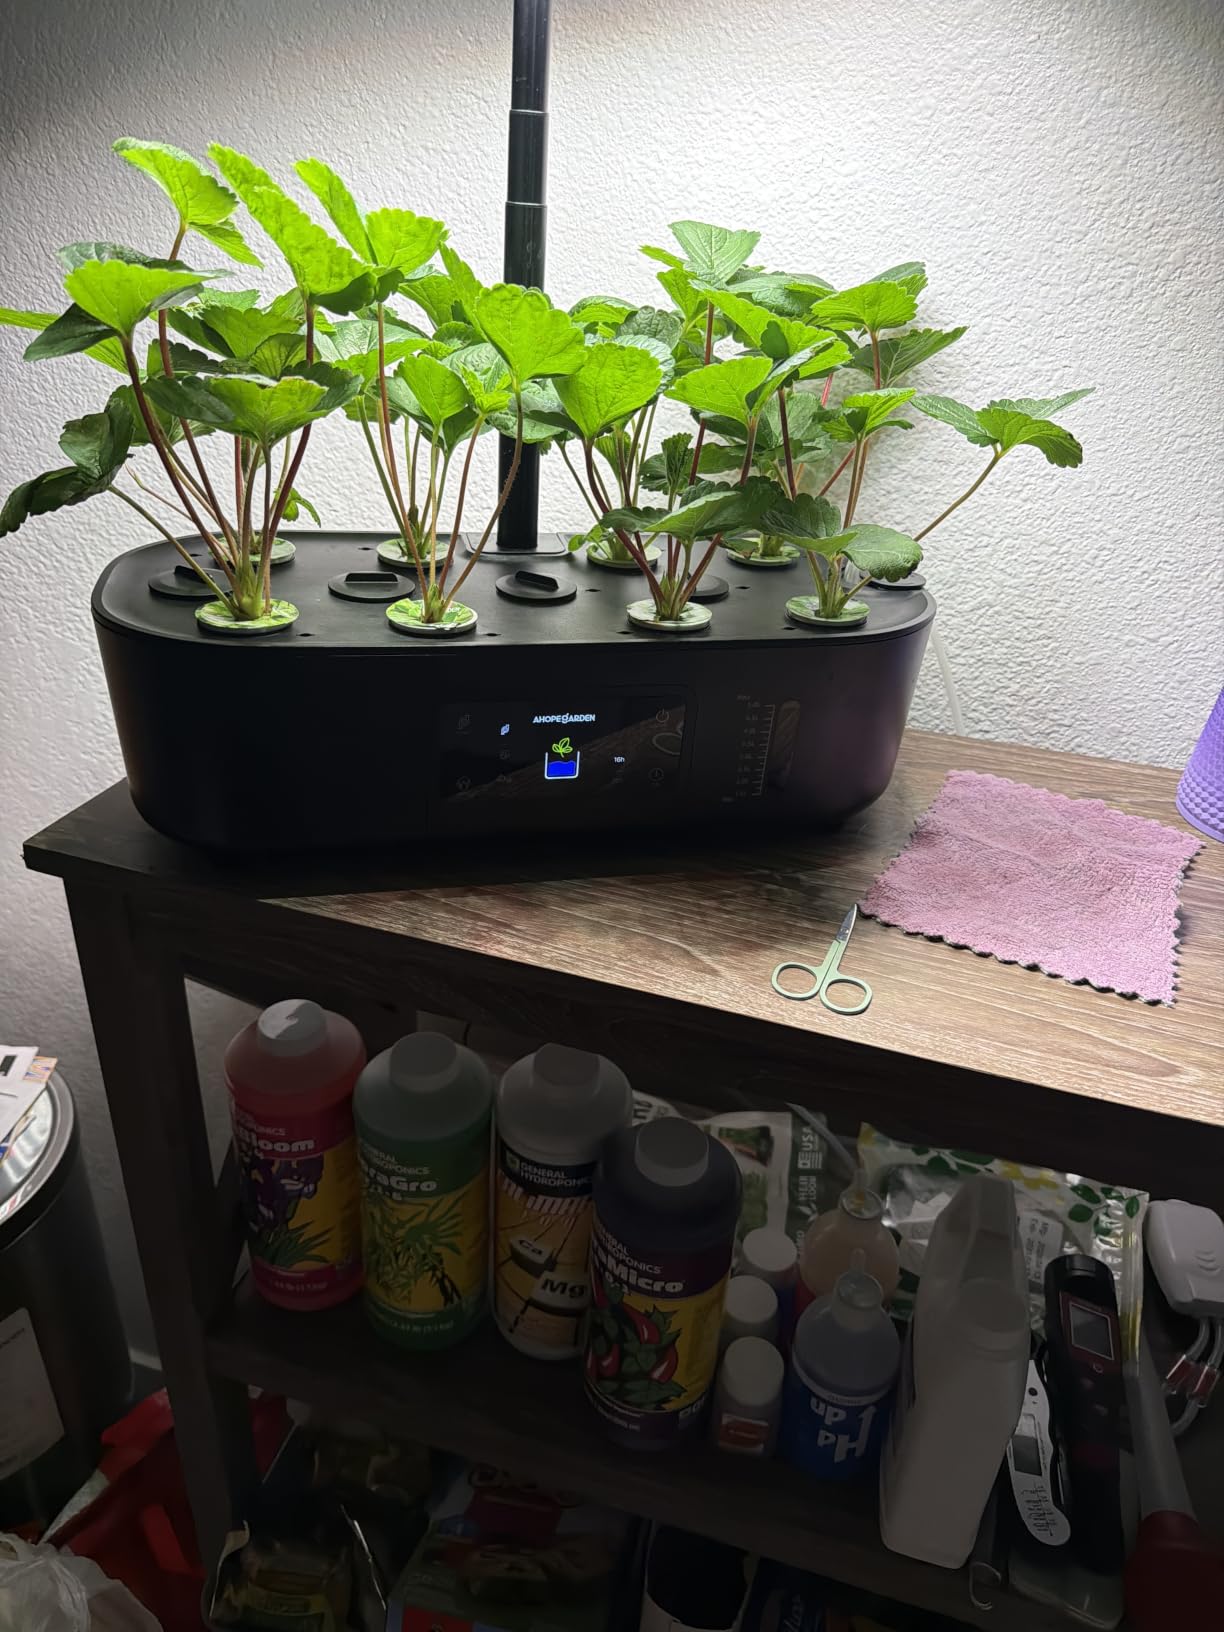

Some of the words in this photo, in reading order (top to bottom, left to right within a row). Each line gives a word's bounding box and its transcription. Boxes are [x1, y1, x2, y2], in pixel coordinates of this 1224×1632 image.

[613, 756, 626, 764] 16h
[520, 1162, 568, 1179] GENERAL
[520, 1170, 593, 1188] HYDROPONIC
[518, 1239, 543, 1255] Ca
[541, 1278, 587, 1299] Mg
